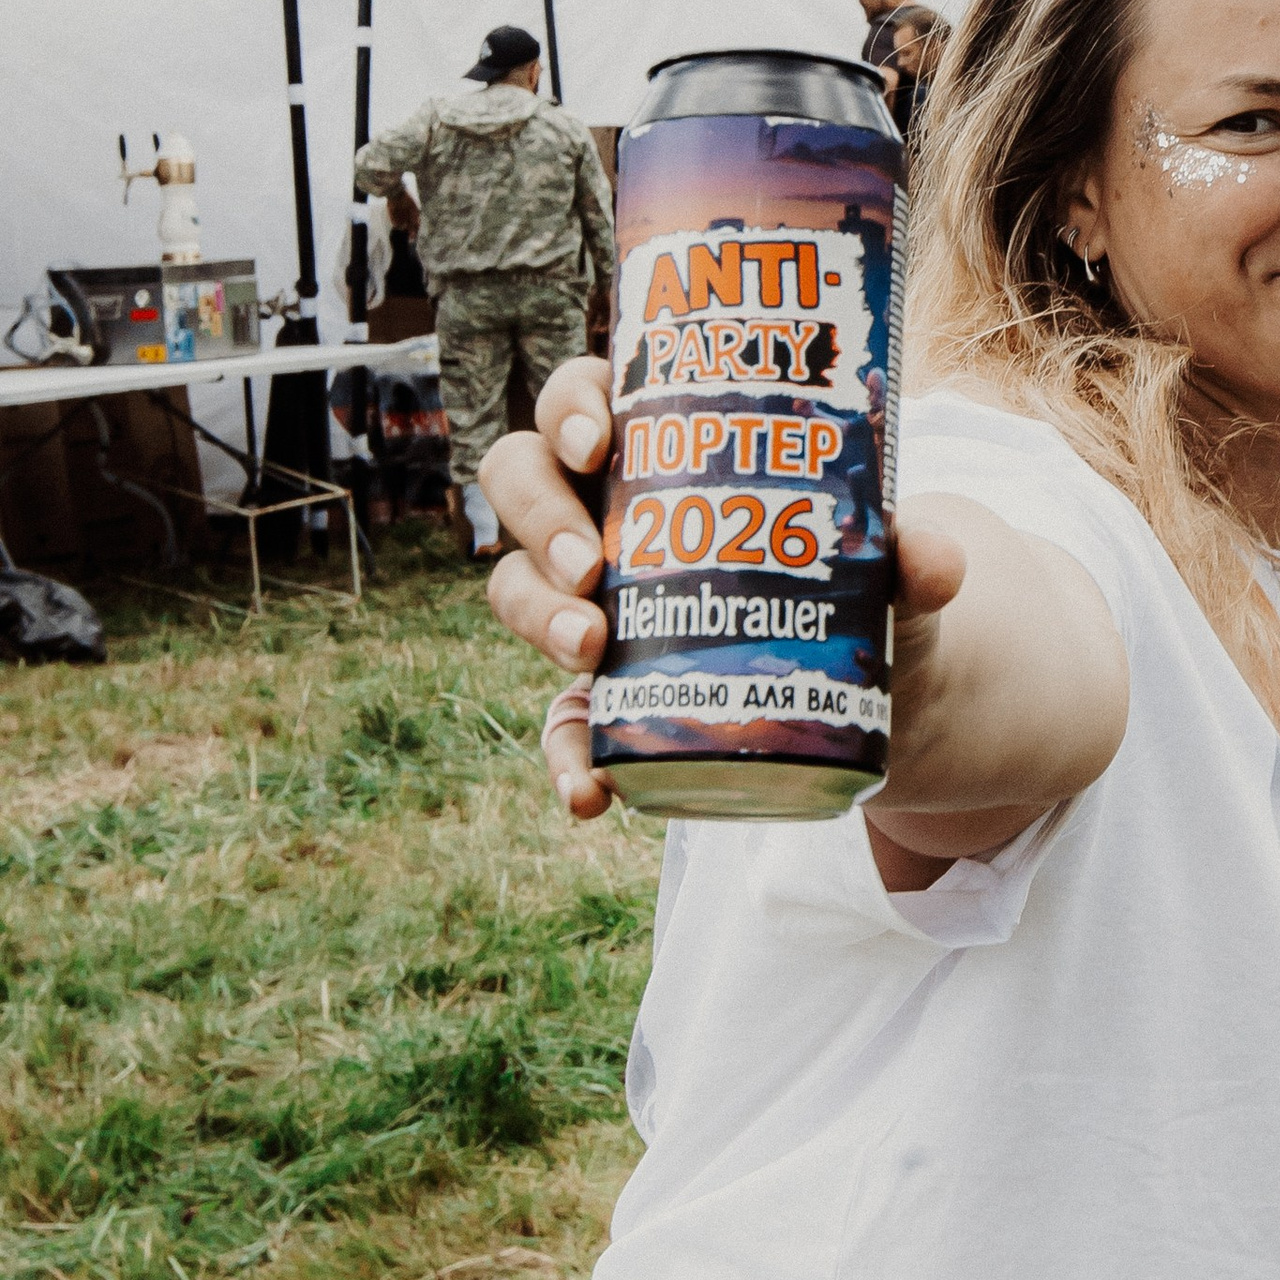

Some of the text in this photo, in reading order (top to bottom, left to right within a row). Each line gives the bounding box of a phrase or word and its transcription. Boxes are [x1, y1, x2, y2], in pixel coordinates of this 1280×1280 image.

[643, 240, 842, 322] ANTI-
[646, 322, 818, 386] PARTY
[624, 412, 841, 479] ПОРТЕР
[629, 494, 819, 568] 2026
[616, 581, 836, 642] Heimbrauer
[619, 683, 729, 710] ЛЮБОВЬЮ
[743, 683, 796, 709] ДЛЯ
[808, 687, 849, 715] ВАС
